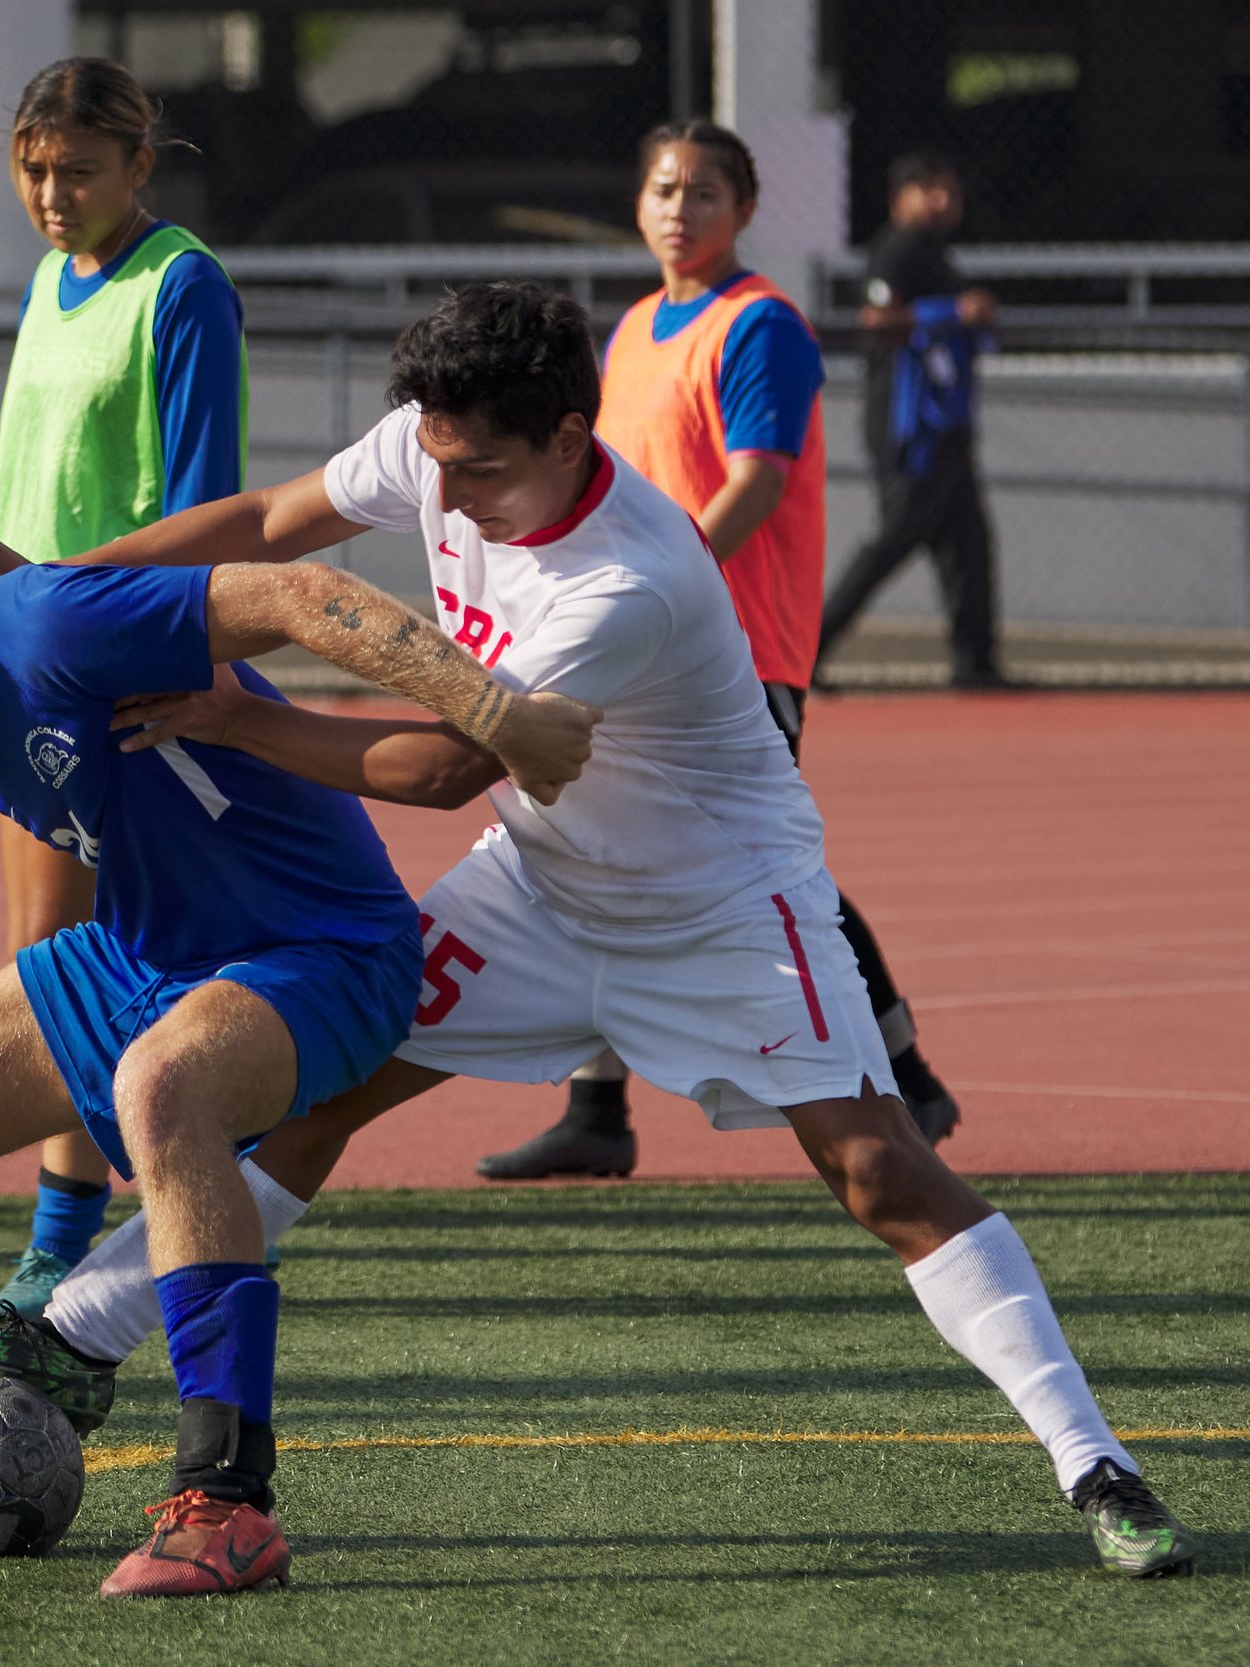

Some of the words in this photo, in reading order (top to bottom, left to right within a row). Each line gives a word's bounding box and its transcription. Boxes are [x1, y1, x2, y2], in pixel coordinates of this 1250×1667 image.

[37, 726, 77, 747] COLLEGE
[52, 754, 81, 789] CORSAIRS
[414, 912, 488, 1027] 5
